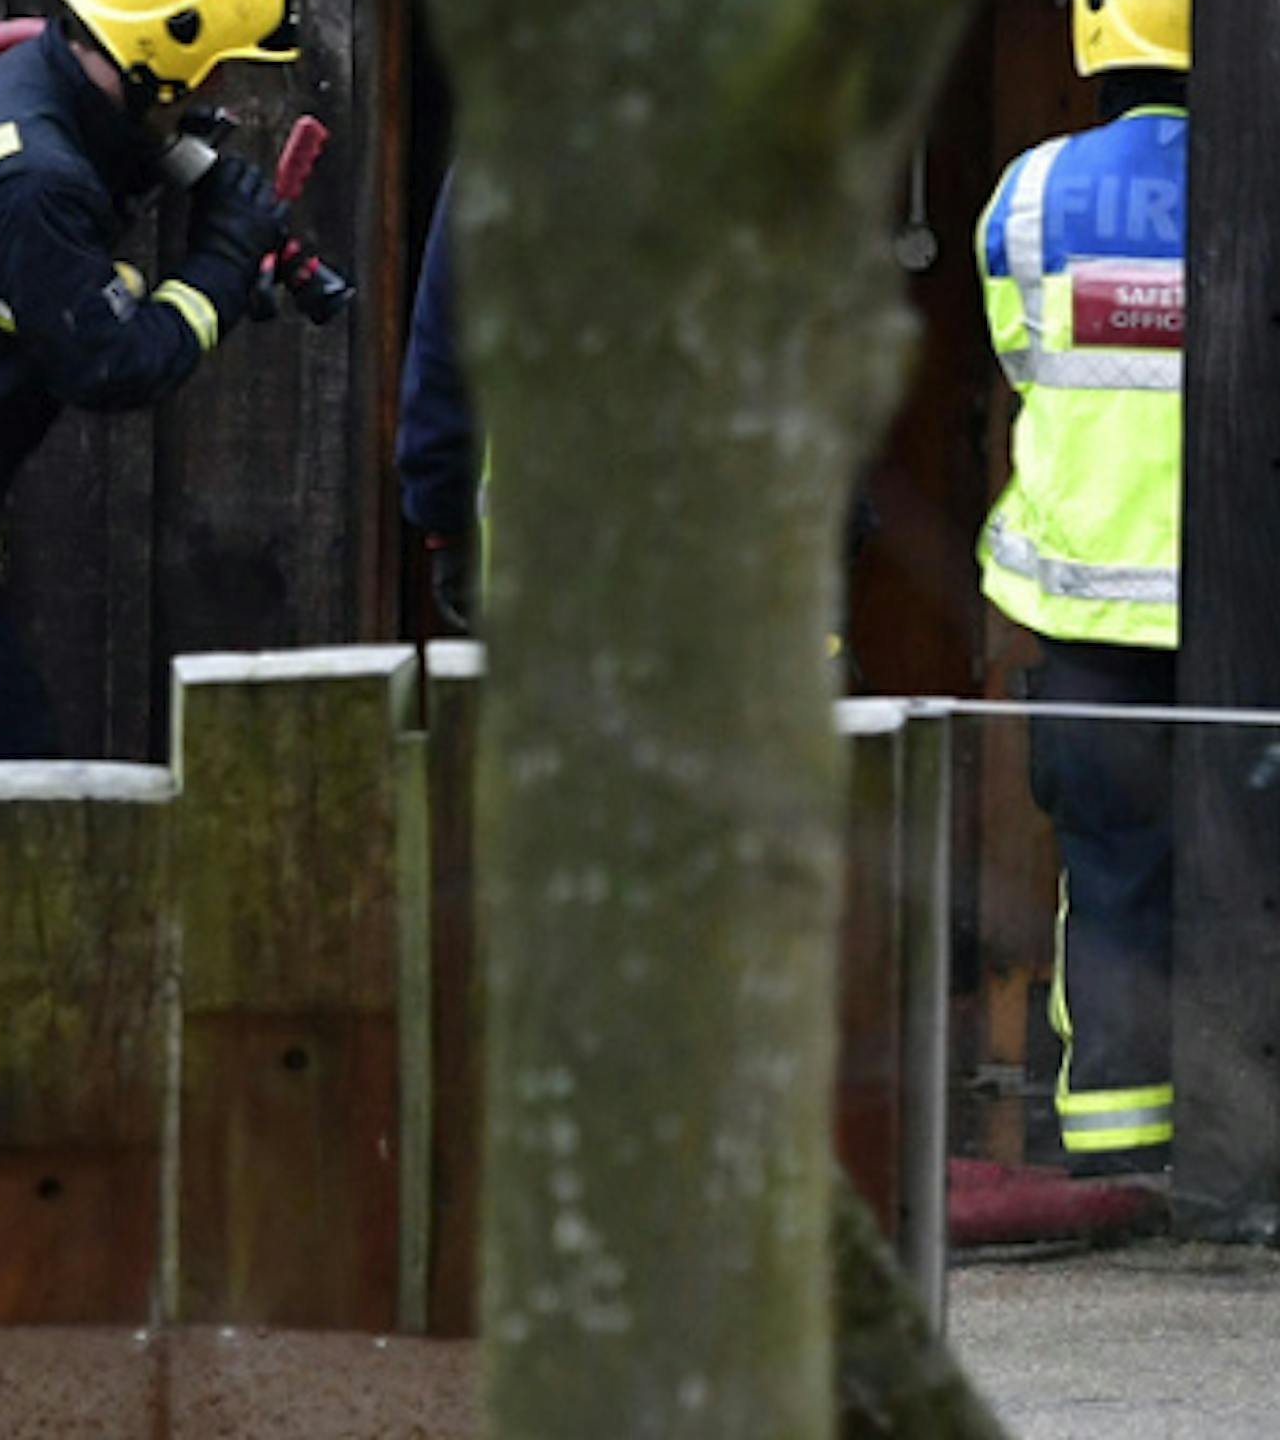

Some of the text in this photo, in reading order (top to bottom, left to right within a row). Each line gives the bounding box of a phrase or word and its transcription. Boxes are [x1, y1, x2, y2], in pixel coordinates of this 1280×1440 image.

[1047, 175, 1182, 242] FIR
[1116, 285, 1185, 308] SAFET
[1110, 310, 1184, 331] OFFIC
